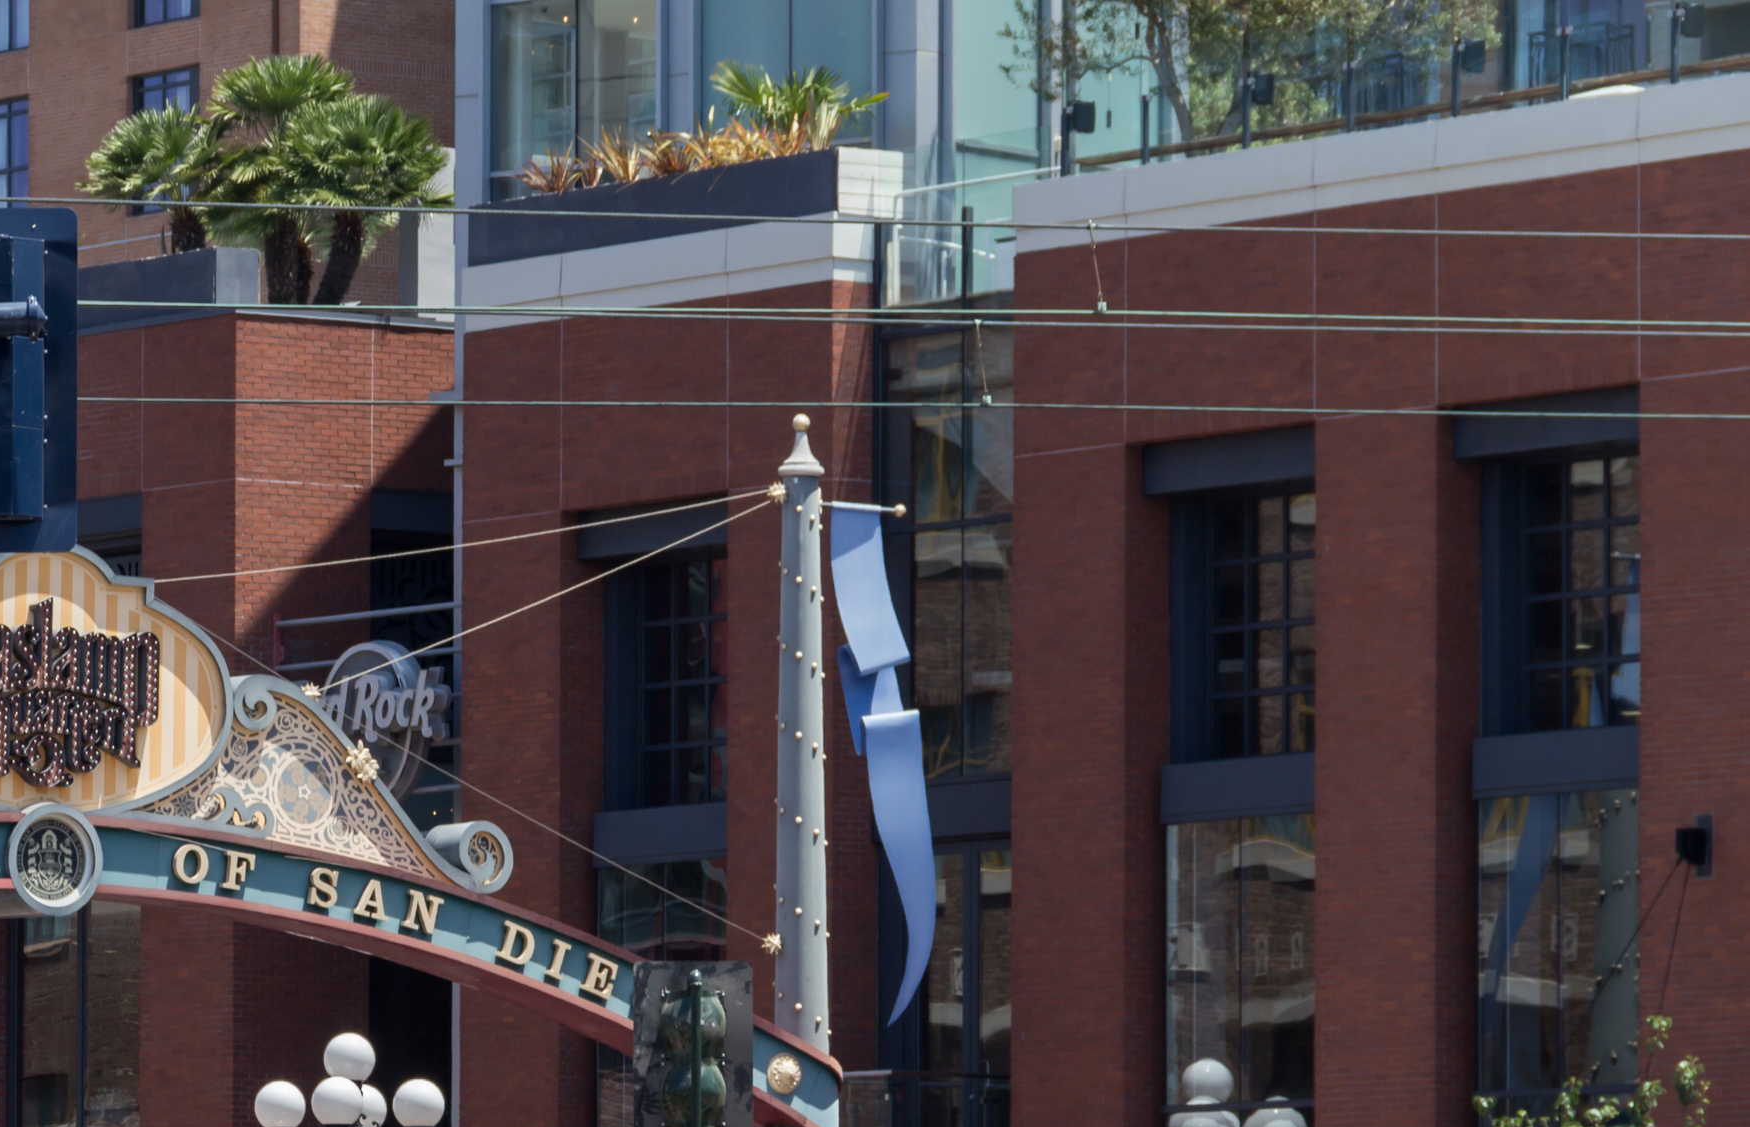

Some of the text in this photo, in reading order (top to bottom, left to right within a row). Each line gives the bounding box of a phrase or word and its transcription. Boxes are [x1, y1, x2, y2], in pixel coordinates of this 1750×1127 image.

[352, 669, 436, 743] Rock
[173, 843, 256, 891] OF
[307, 866, 444, 935] SAN
[495, 919, 619, 1001] DIE
